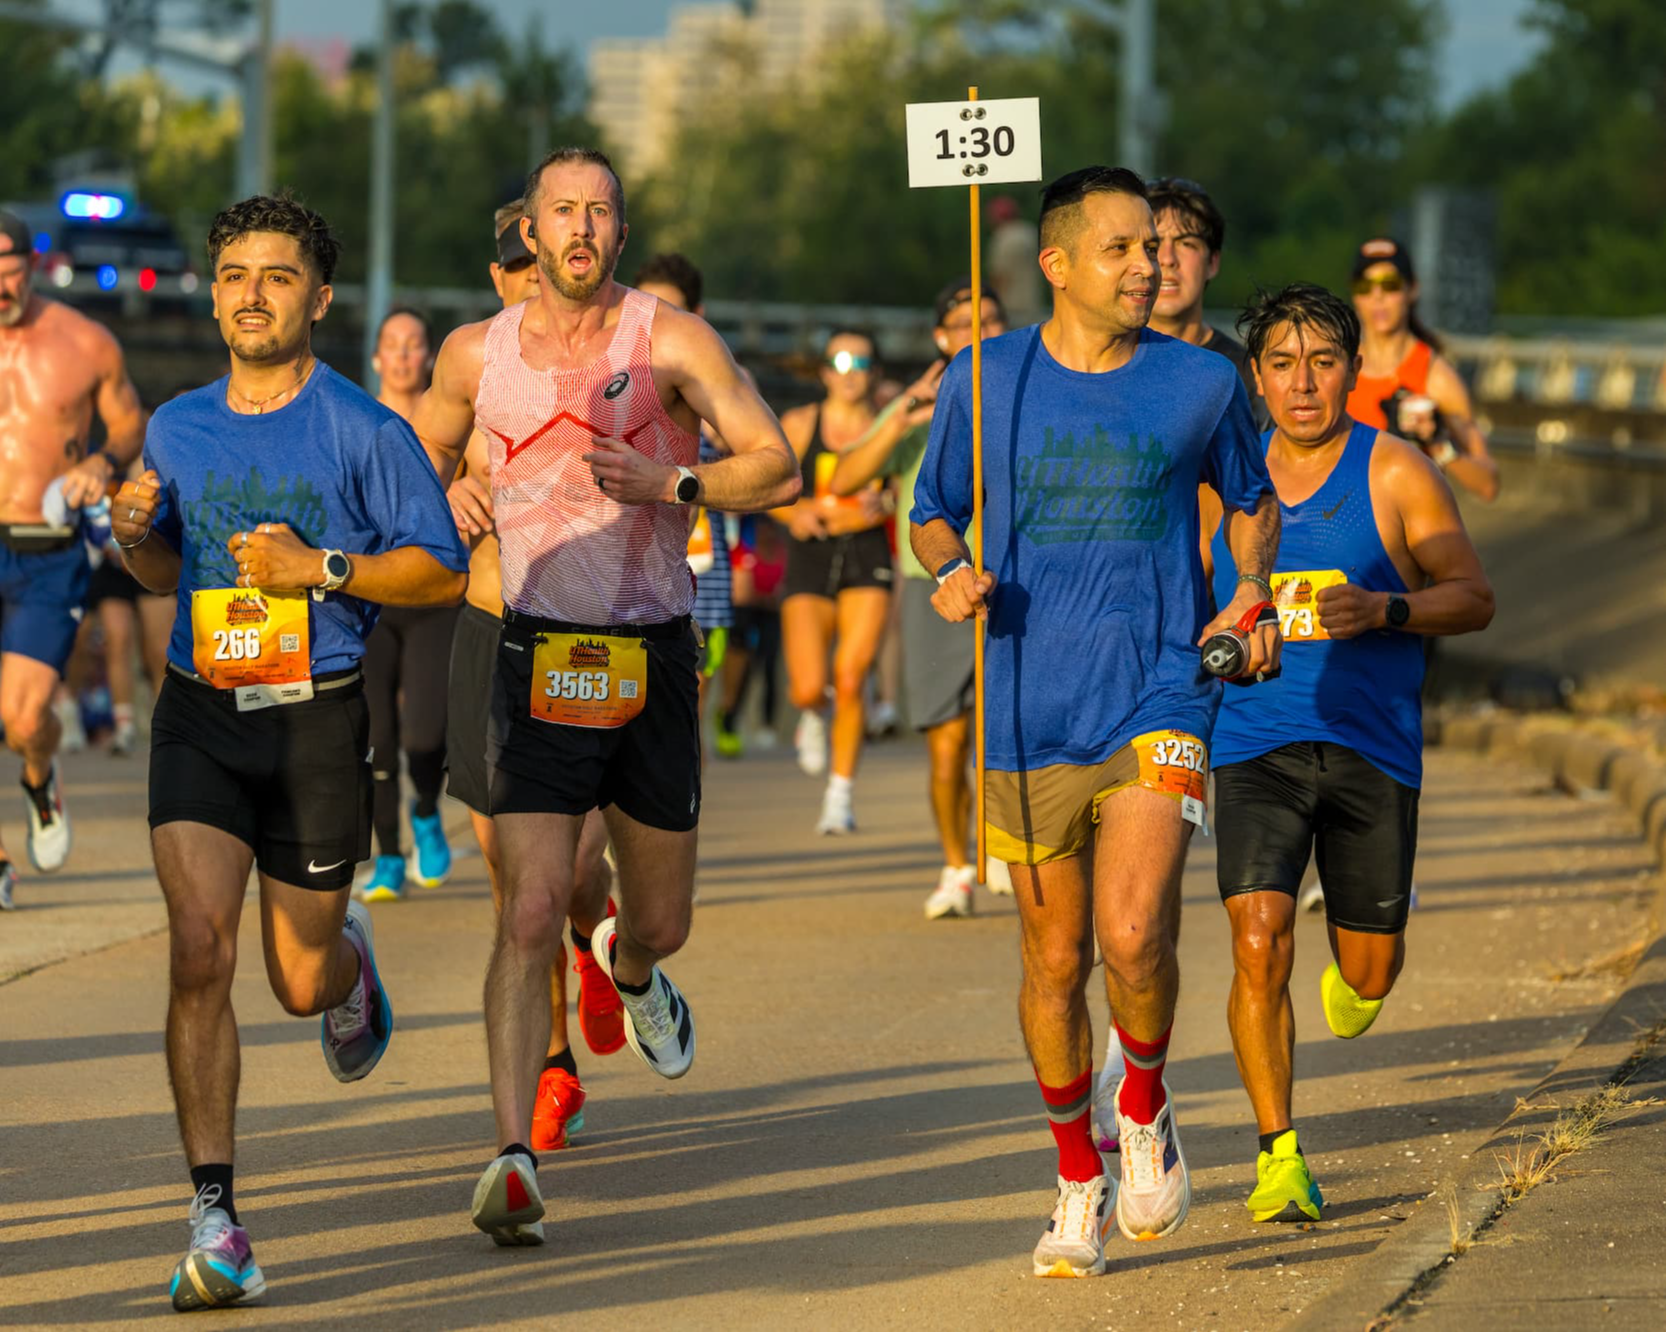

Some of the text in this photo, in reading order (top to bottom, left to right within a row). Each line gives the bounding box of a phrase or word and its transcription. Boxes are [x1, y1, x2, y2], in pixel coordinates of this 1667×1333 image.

[935, 126, 1015, 160] 1:30
[1016, 489, 1166, 523] Houston
[1278, 608, 1314, 638] 73
[213, 628, 261, 661] 266
[545, 671, 609, 701] 3563
[1151, 739, 1205, 775] 3252
